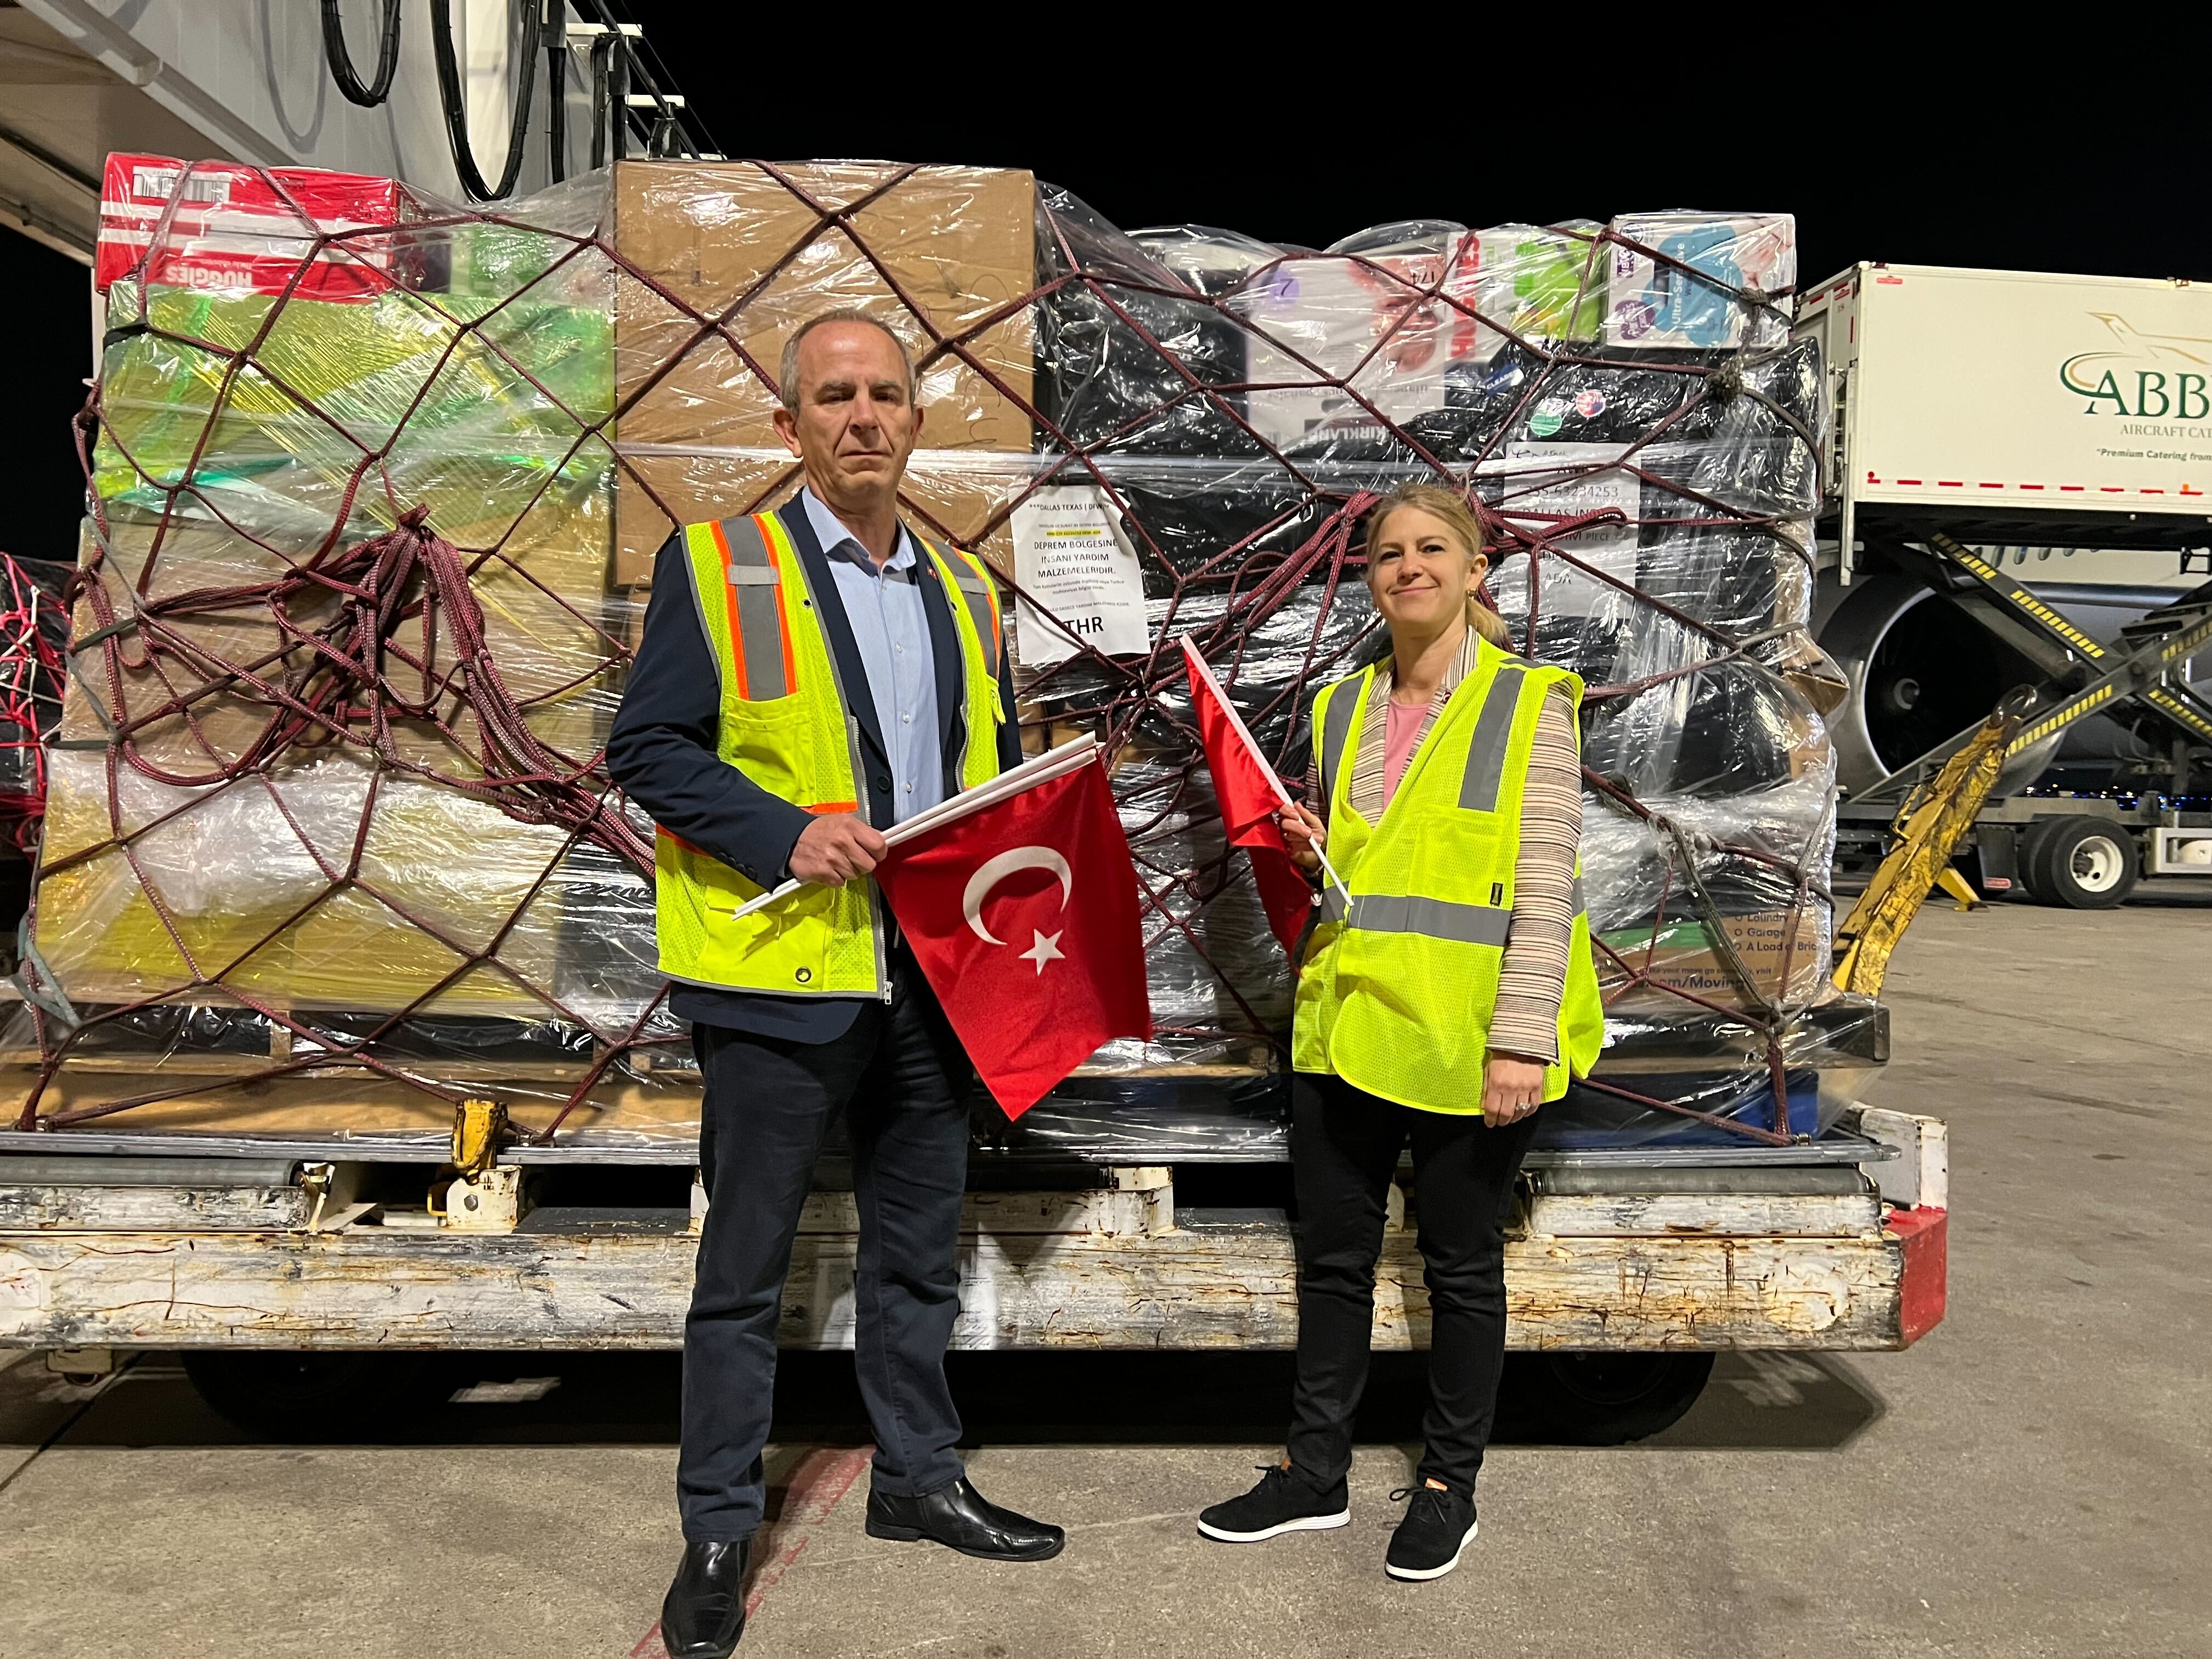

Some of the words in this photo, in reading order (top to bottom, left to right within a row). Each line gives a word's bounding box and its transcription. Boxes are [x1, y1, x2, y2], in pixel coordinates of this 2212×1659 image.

[165, 265, 252, 288] HUGGIES
[1671, 242, 1684, 325] Ultra-Senstive
[2083, 369, 2212, 419] ABB
[2120, 424, 2186, 437] AIRCRAFT
[2146, 450, 2187, 461] Catering
[2190, 452, 2212, 461] from
[1526, 485, 1618, 498] 35-63234253
[1034, 541, 1066, 550] DEPREM
[1063, 617, 1104, 634] THR
[1747, 913, 1789, 924] Laundry
[1747, 928, 1786, 939] Garage
[1746, 941, 1754, 951] A
[1757, 941, 1783, 951] Load
[1717, 967, 1754, 975] smooy,
